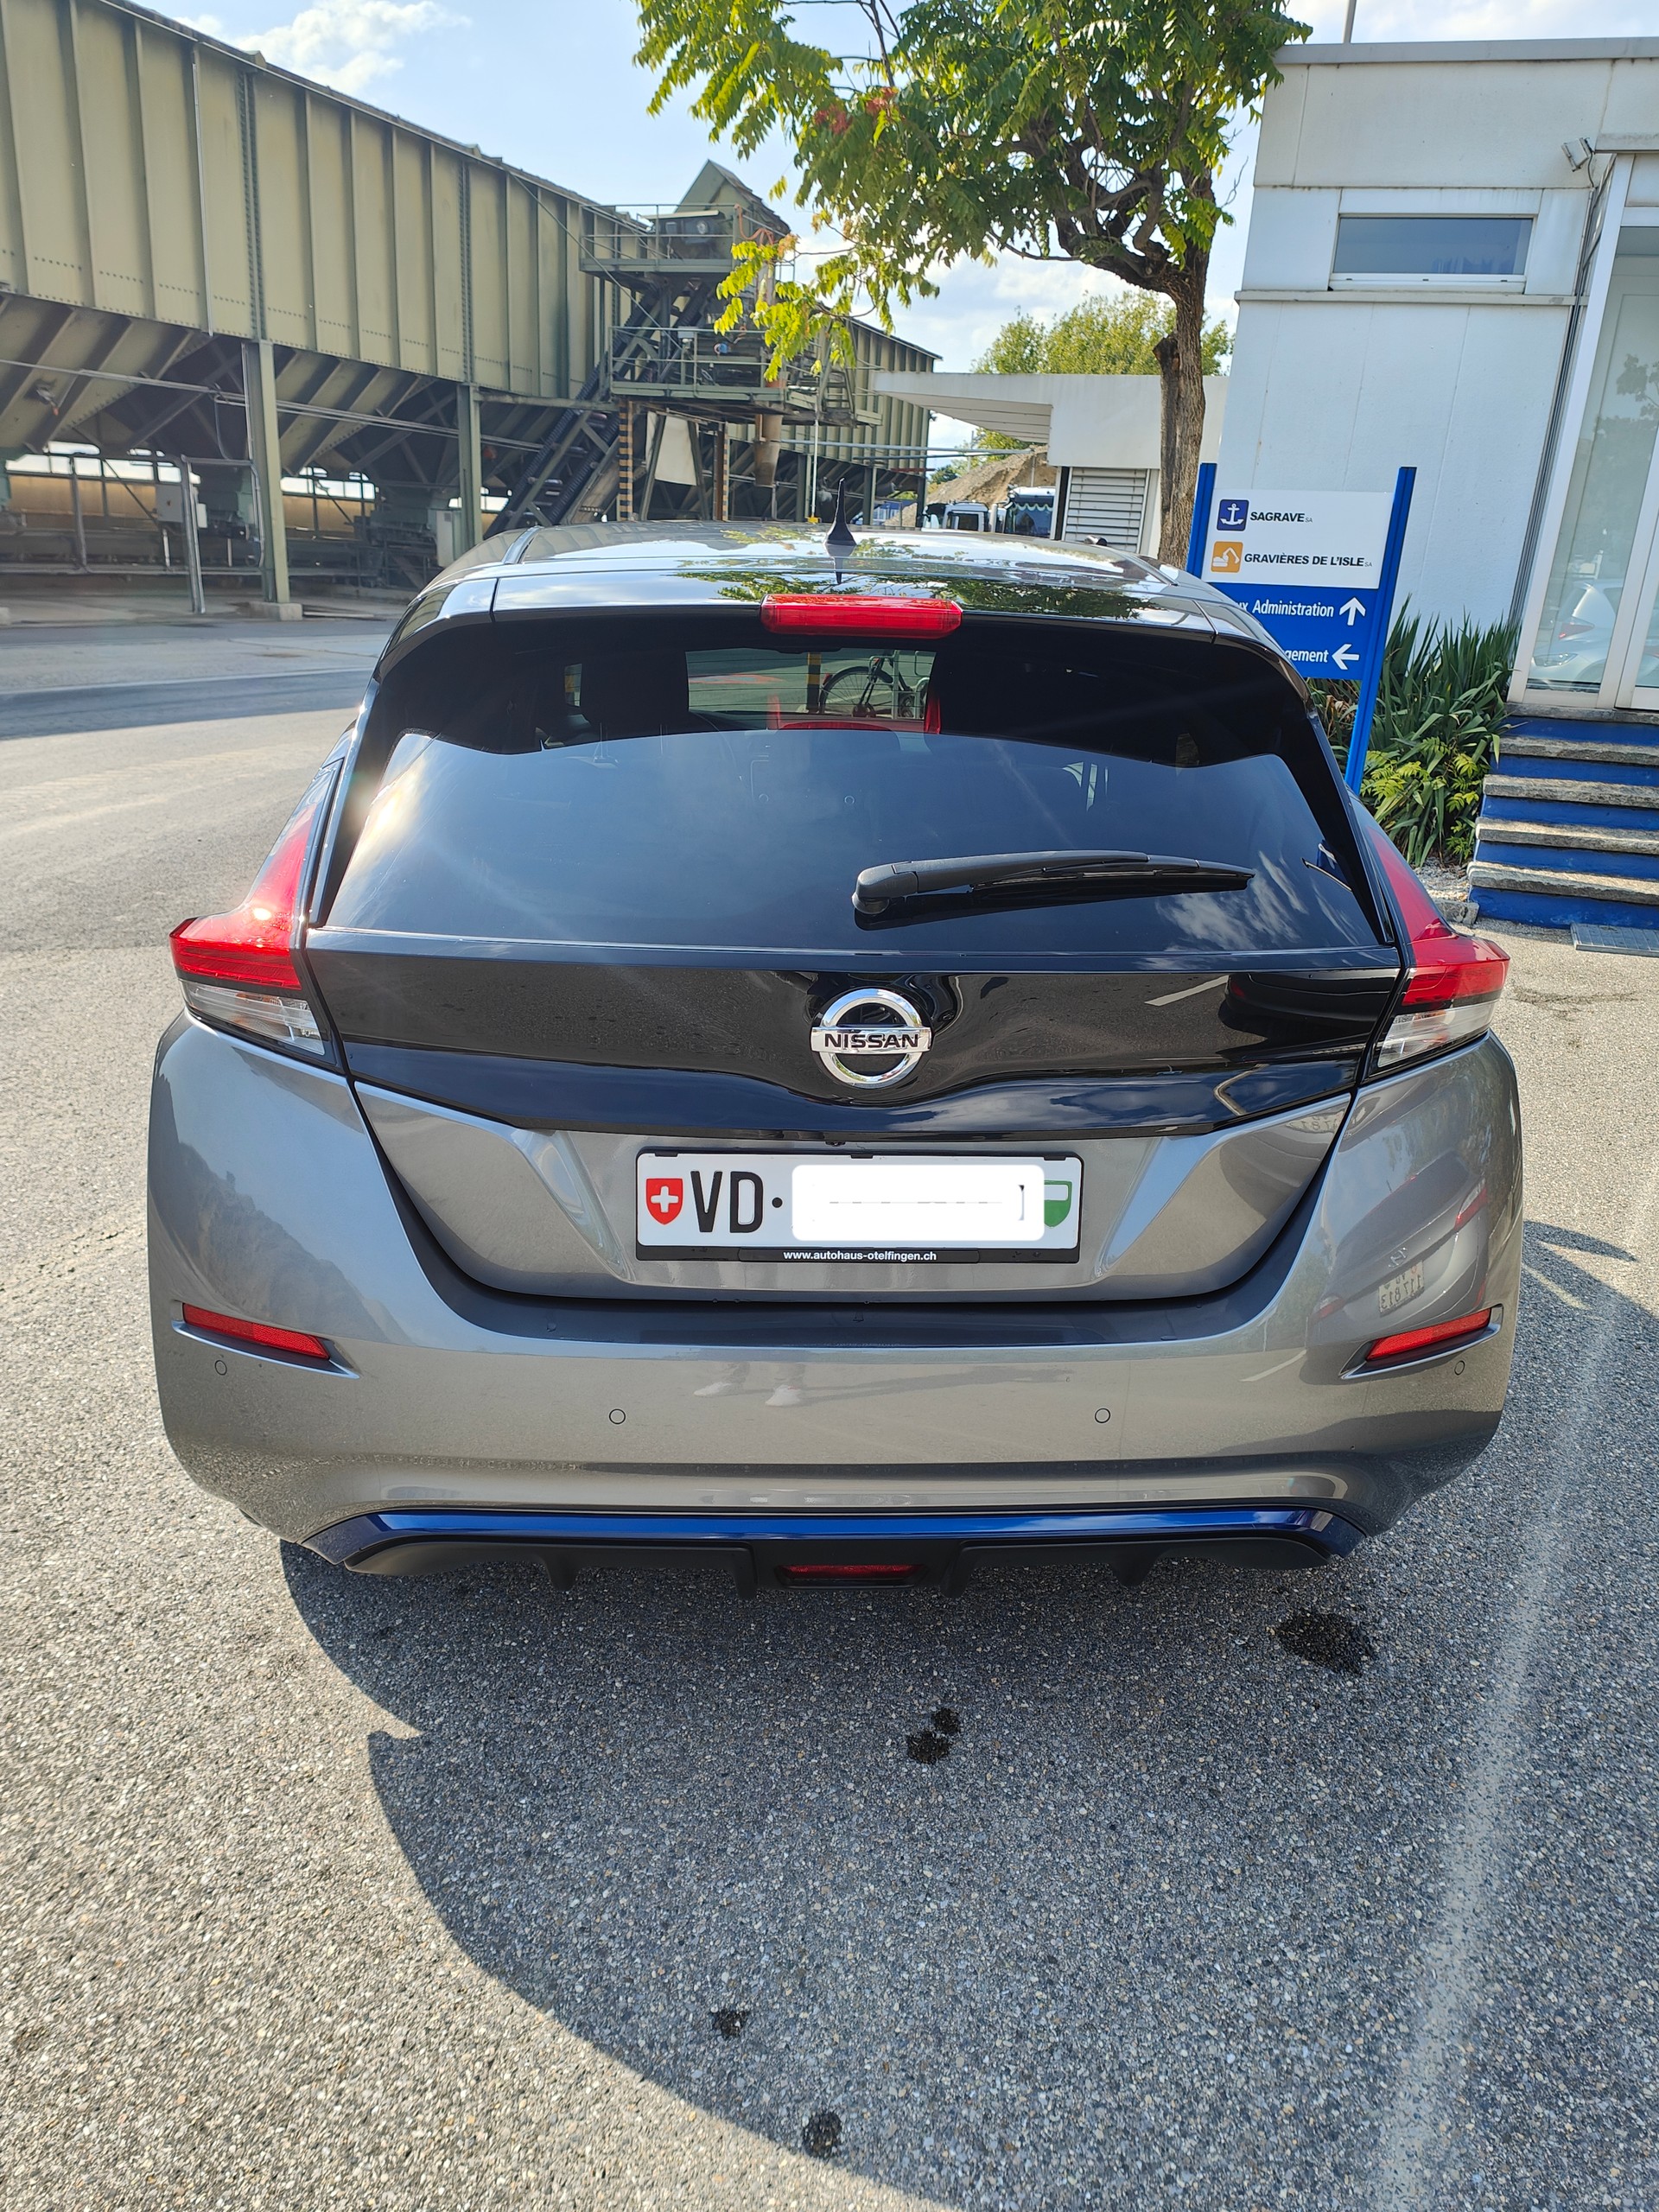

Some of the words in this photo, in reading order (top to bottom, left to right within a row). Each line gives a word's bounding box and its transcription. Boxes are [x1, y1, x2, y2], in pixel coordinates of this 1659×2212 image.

[1249, 512, 1305, 523] SAGRAVE
[1244, 552, 1309, 565] GRAVIÈRES
[1312, 556, 1328, 566] DE
[1330, 556, 1365, 567] L'ISLE
[1252, 600, 1334, 618] Administration
[824, 1033, 919, 1048] NISSAN
[783, 1250, 937, 1262] www.autohaus-otelfingen.ch
